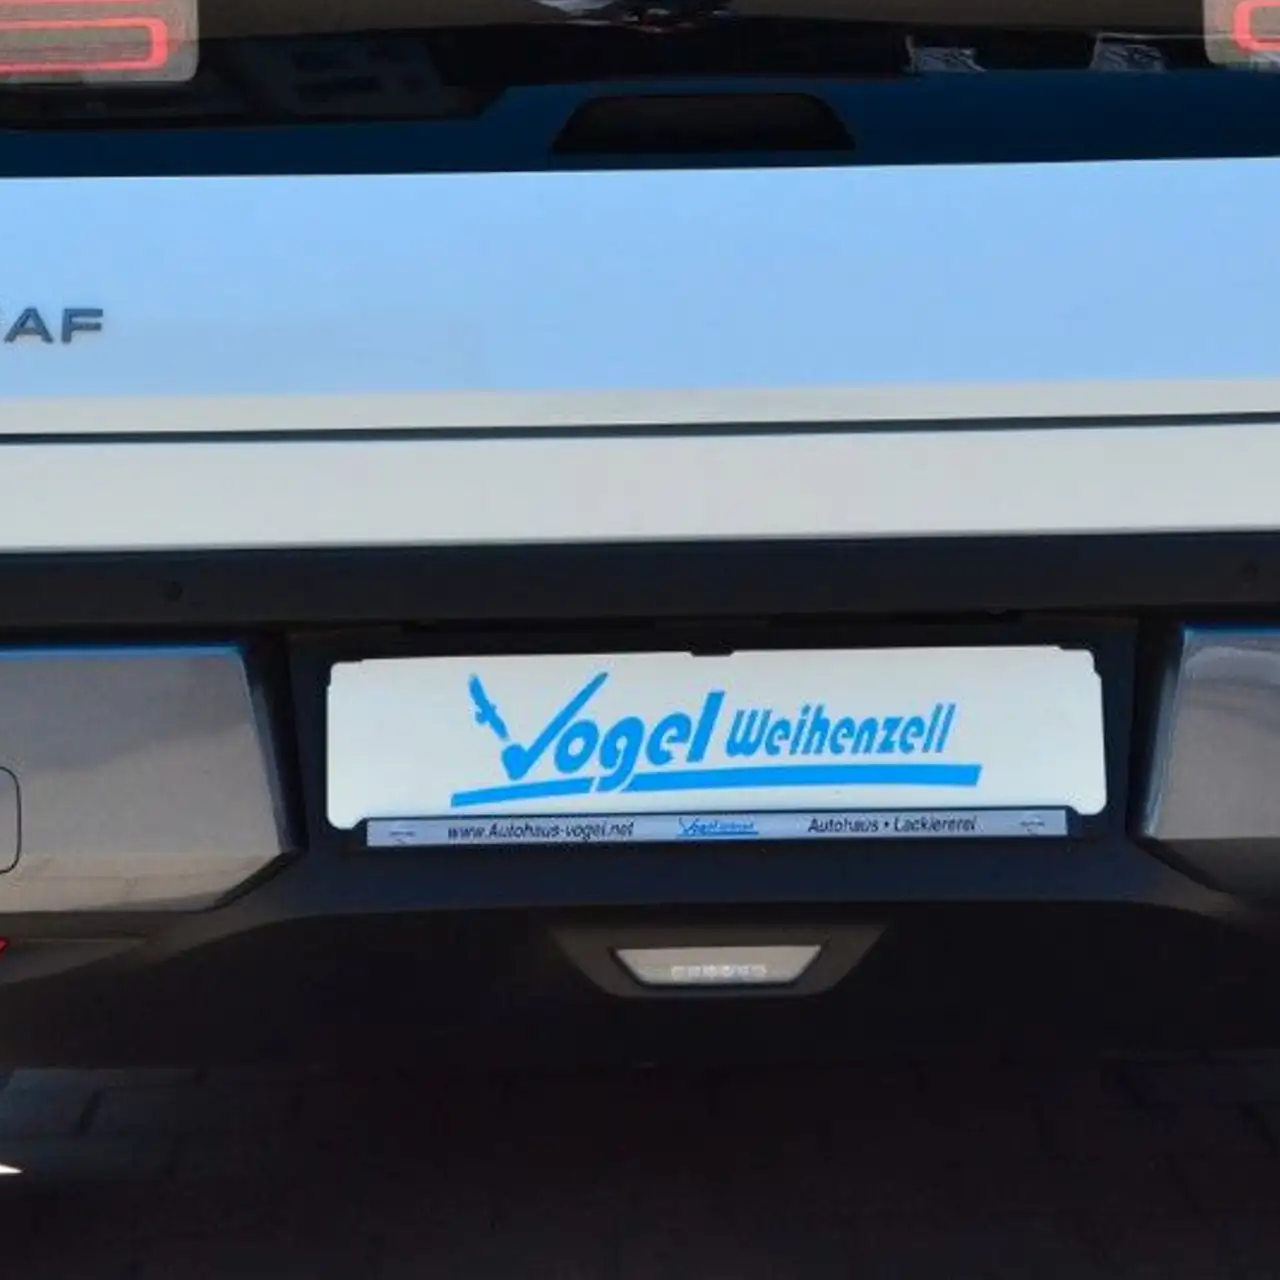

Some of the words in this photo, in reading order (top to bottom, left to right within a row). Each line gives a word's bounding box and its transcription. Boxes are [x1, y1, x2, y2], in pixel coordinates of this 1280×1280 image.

[468, 670, 725, 792] Vogel
[726, 703, 956, 757] Weihenzell
[807, 816, 878, 834] Autohaus
